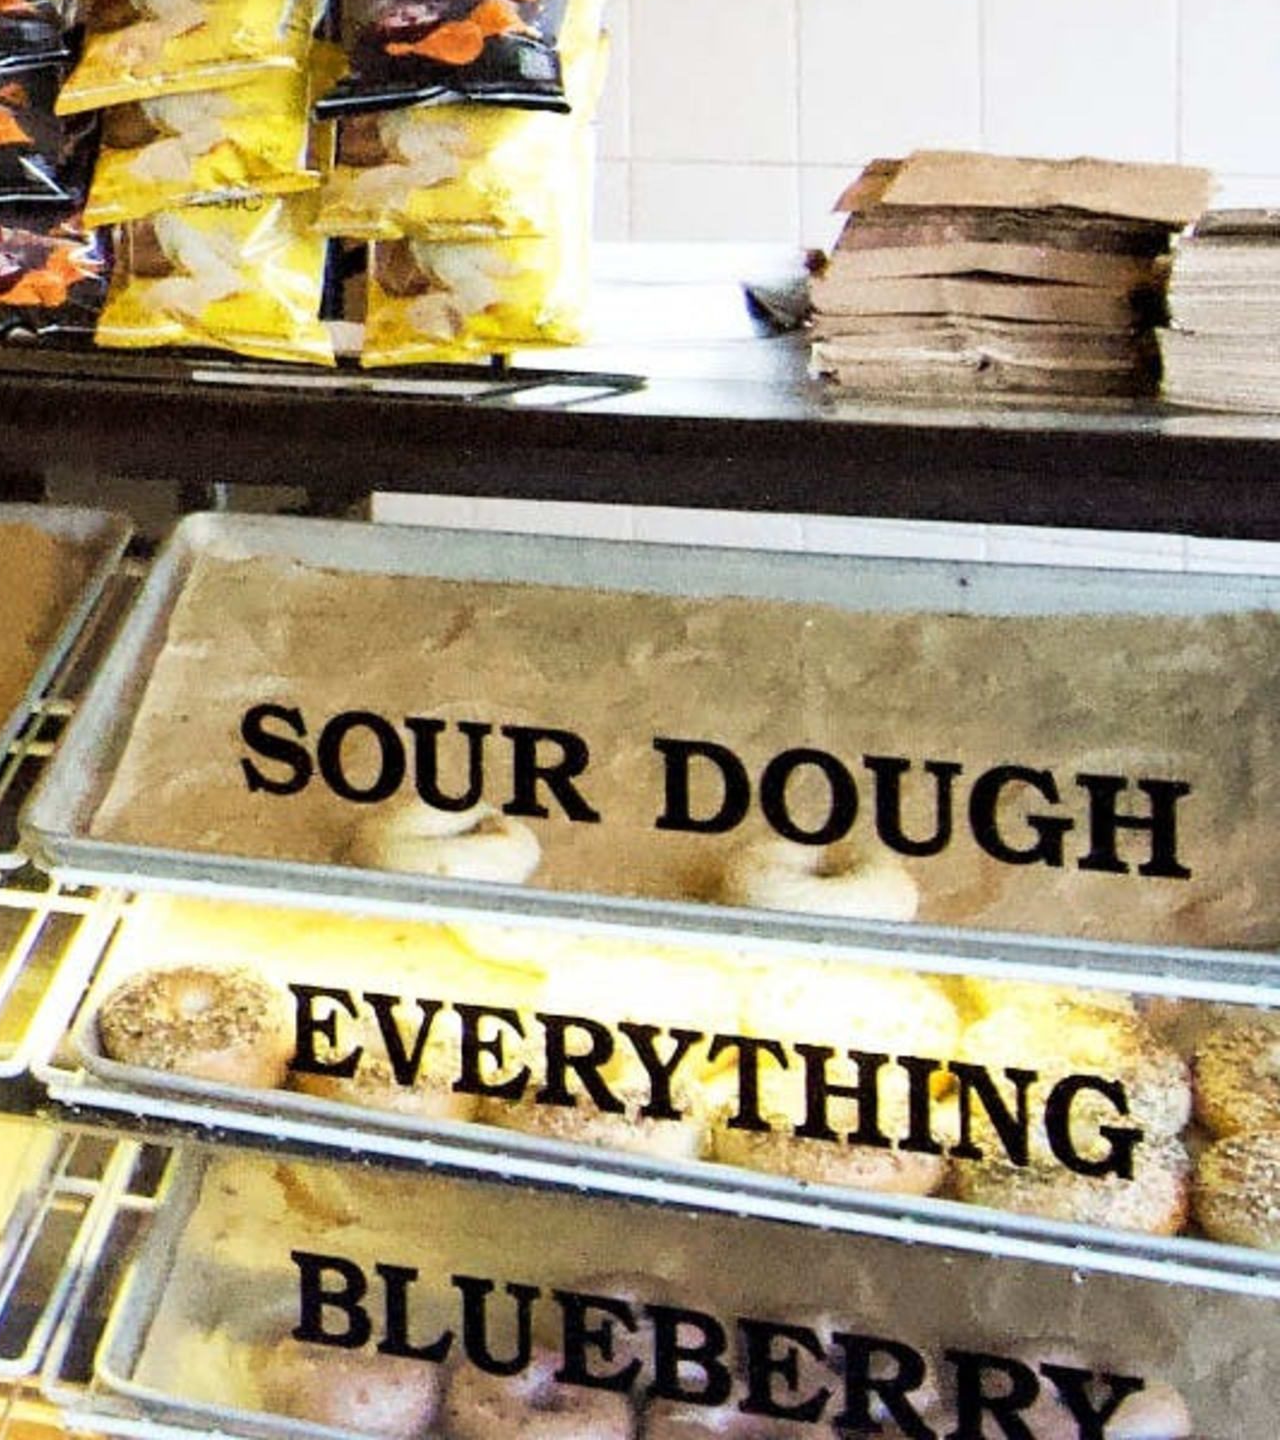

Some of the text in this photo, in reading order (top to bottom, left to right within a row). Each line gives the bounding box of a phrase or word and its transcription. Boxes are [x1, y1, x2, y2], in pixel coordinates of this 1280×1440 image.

[240, 702, 1193, 880] SOUR DOUGH
[288, 982, 1146, 1181] EVERYTHING
[290, 1249, 1146, 1440] BLUEBERRY
